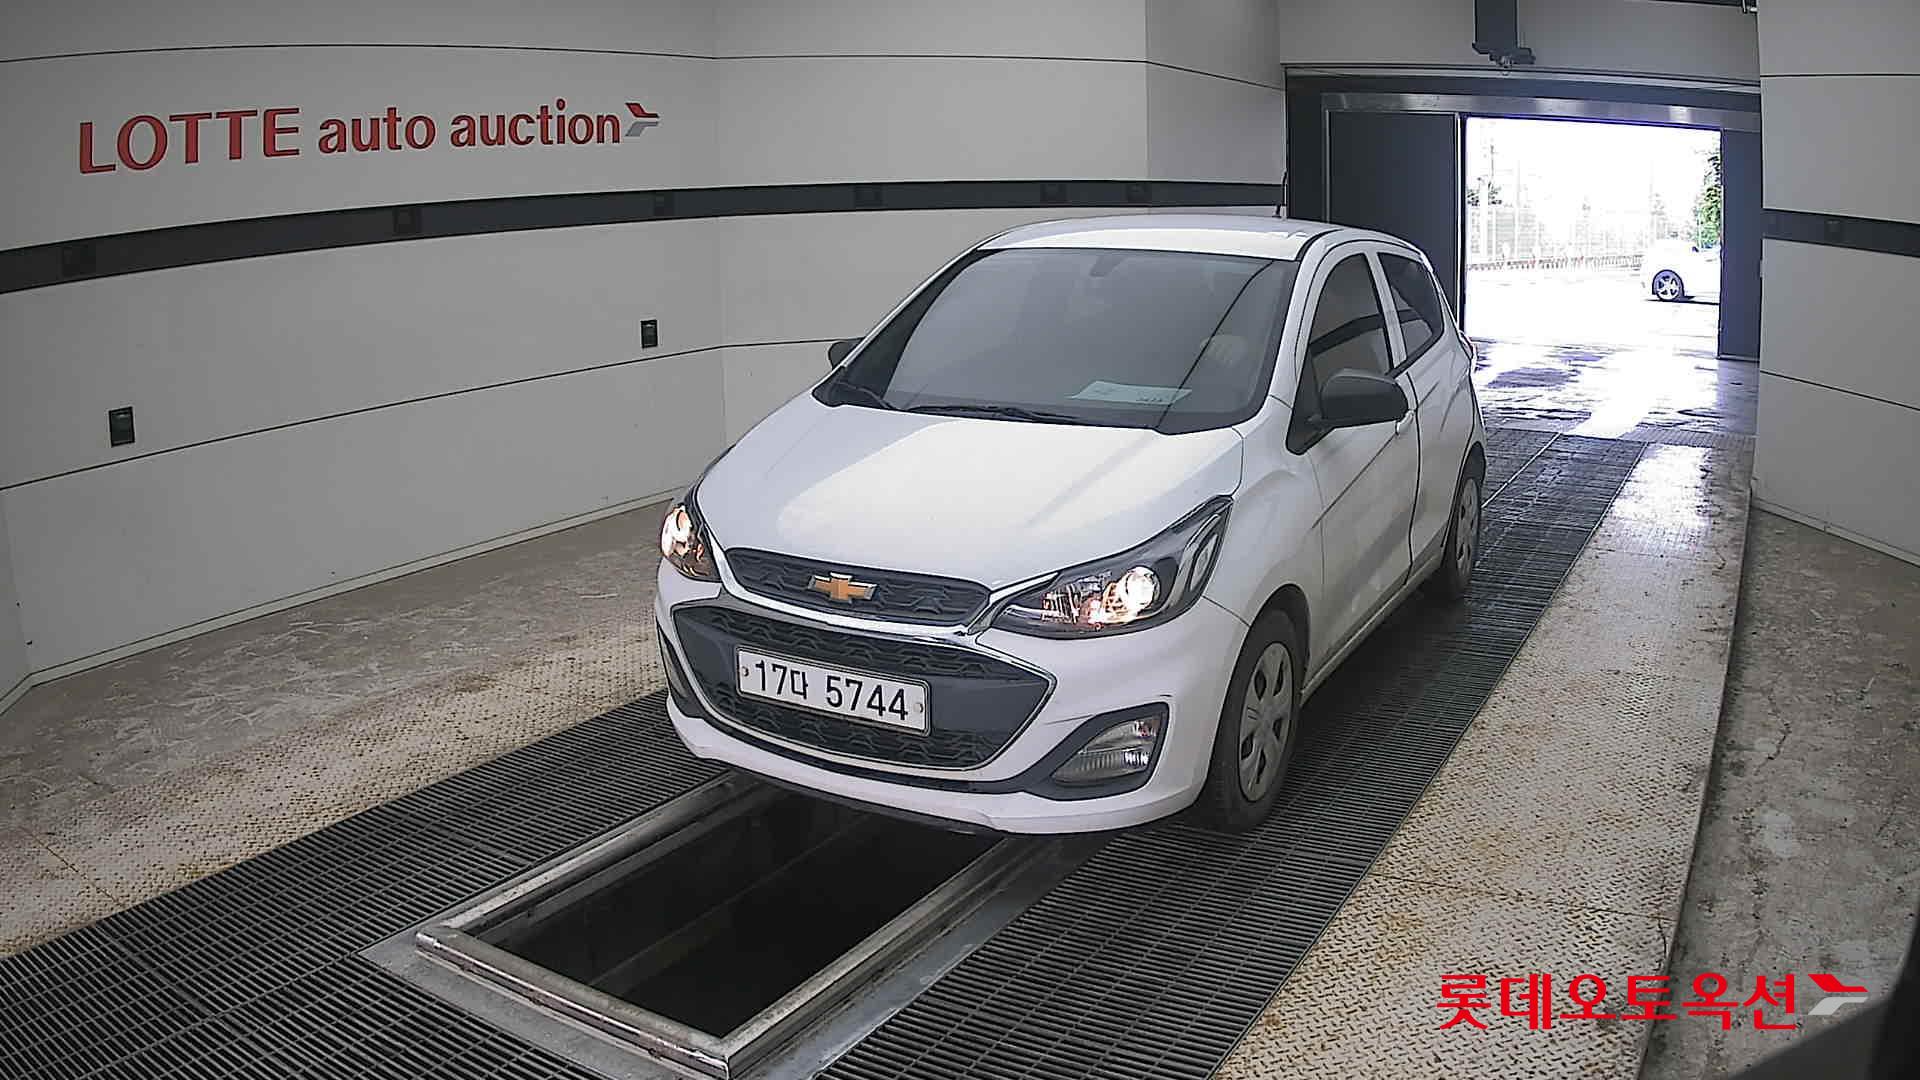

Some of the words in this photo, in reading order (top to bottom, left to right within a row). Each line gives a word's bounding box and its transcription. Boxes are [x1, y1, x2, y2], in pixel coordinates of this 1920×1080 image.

[79, 107, 300, 174] LOTTE
[318, 107, 436, 153] auto
[450, 99, 621, 147] auction
[755, 660, 808, 700] 17다
[826, 675, 908, 720] 5744
